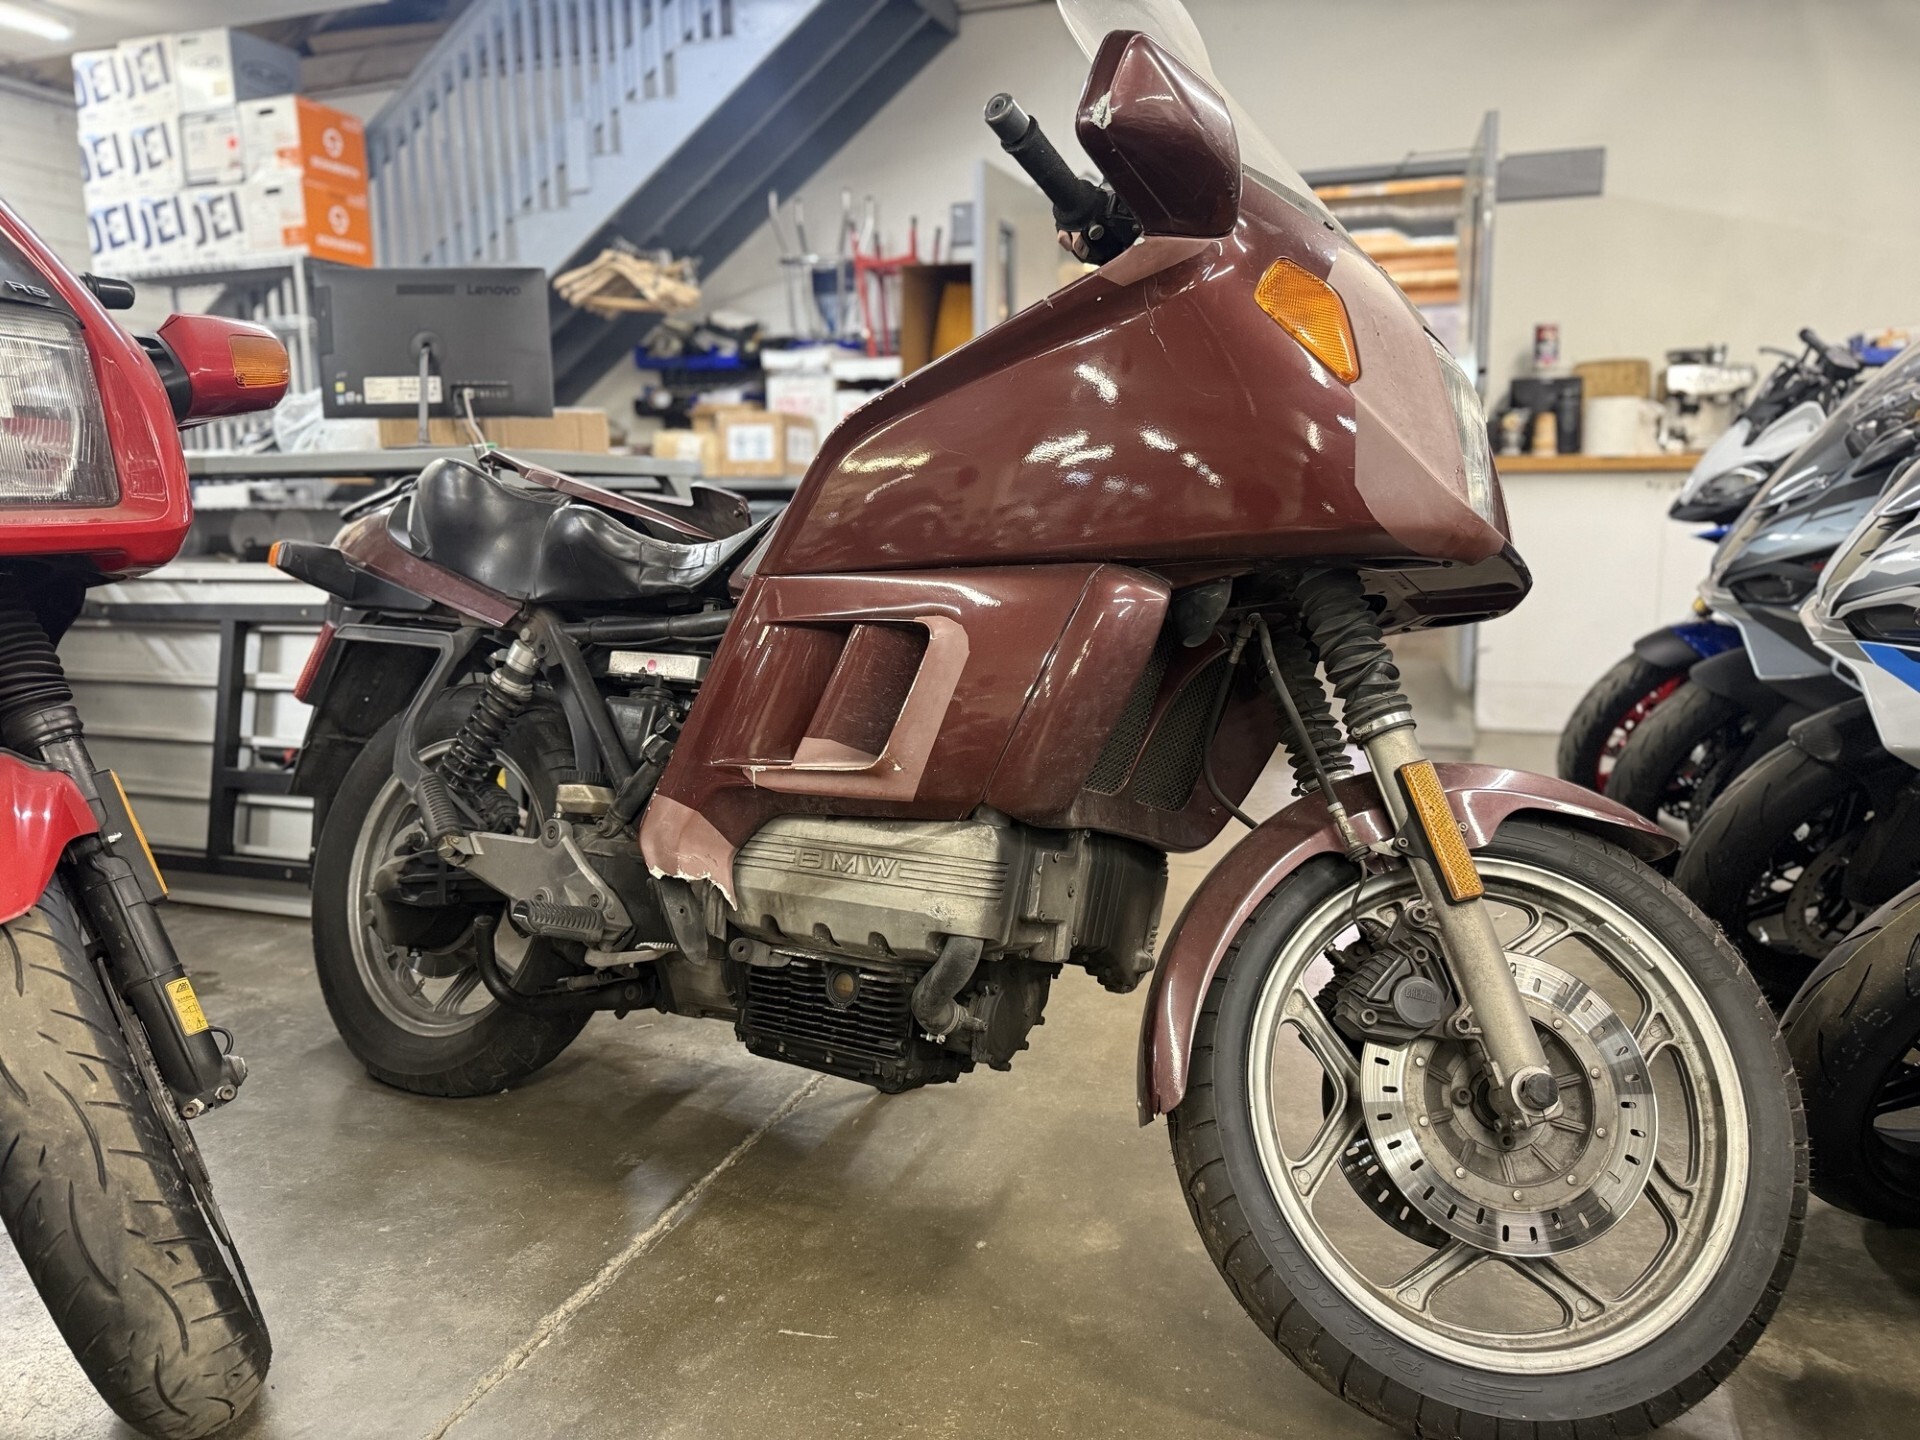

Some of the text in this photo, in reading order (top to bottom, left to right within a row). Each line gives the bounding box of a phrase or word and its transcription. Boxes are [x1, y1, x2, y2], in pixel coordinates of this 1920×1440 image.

[4, 279, 51, 299] RS
[466, 282, 522, 296] Lenovo
[797, 849, 898, 878] BMW
[1602, 869, 1729, 984] MICHELIN
